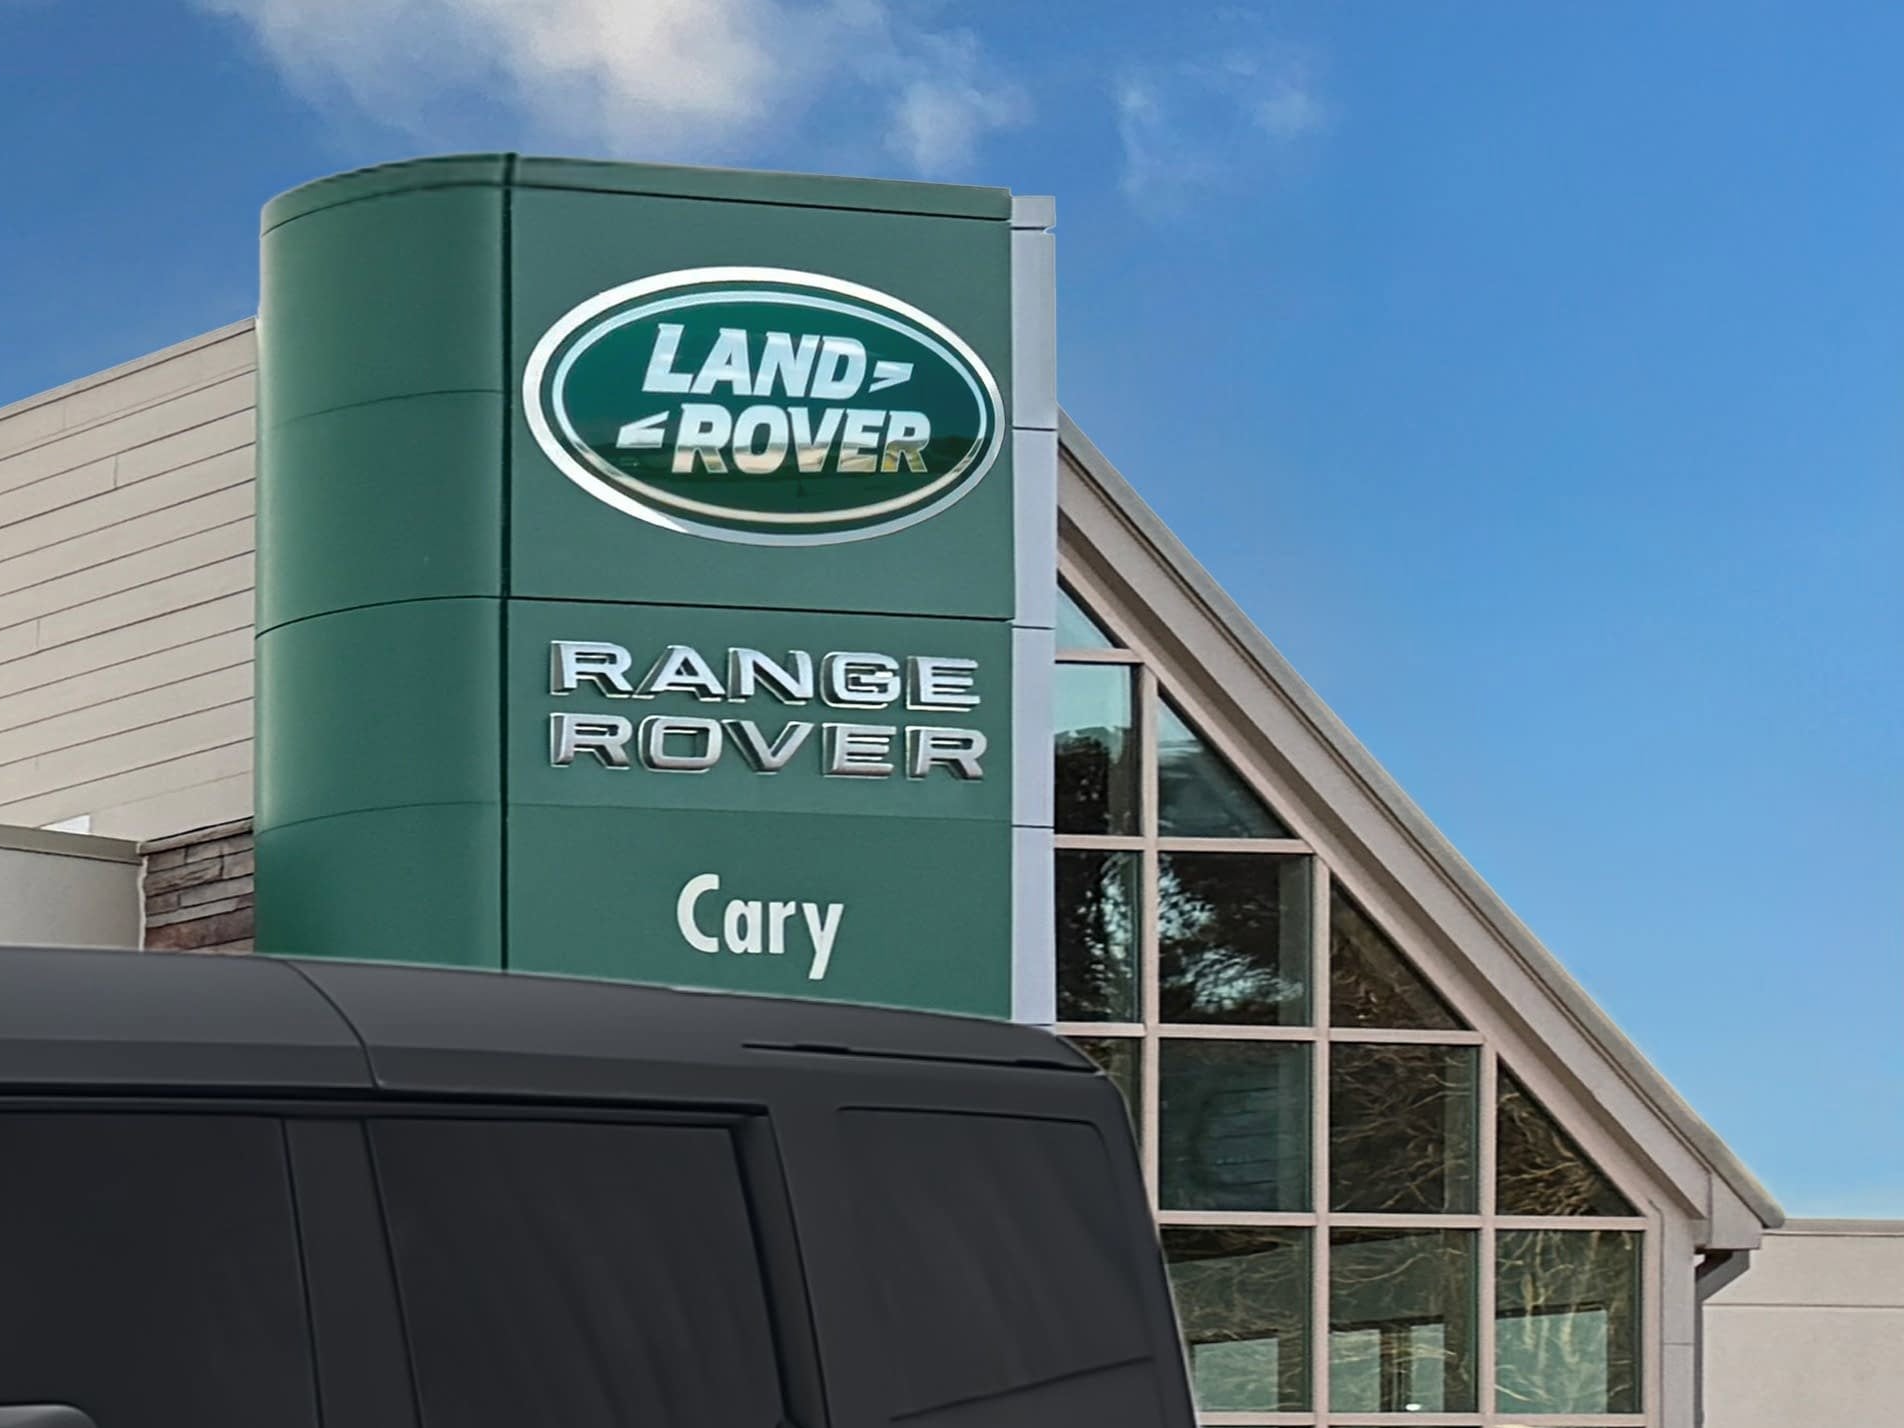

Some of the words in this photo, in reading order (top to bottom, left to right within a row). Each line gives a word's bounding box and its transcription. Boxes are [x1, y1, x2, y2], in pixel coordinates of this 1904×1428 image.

[642, 323, 867, 400] LAND
[672, 403, 931, 474] ROVER
[550, 640, 980, 710] RANGE
[549, 711, 988, 781] ROVER
[677, 874, 844, 980] Cary
